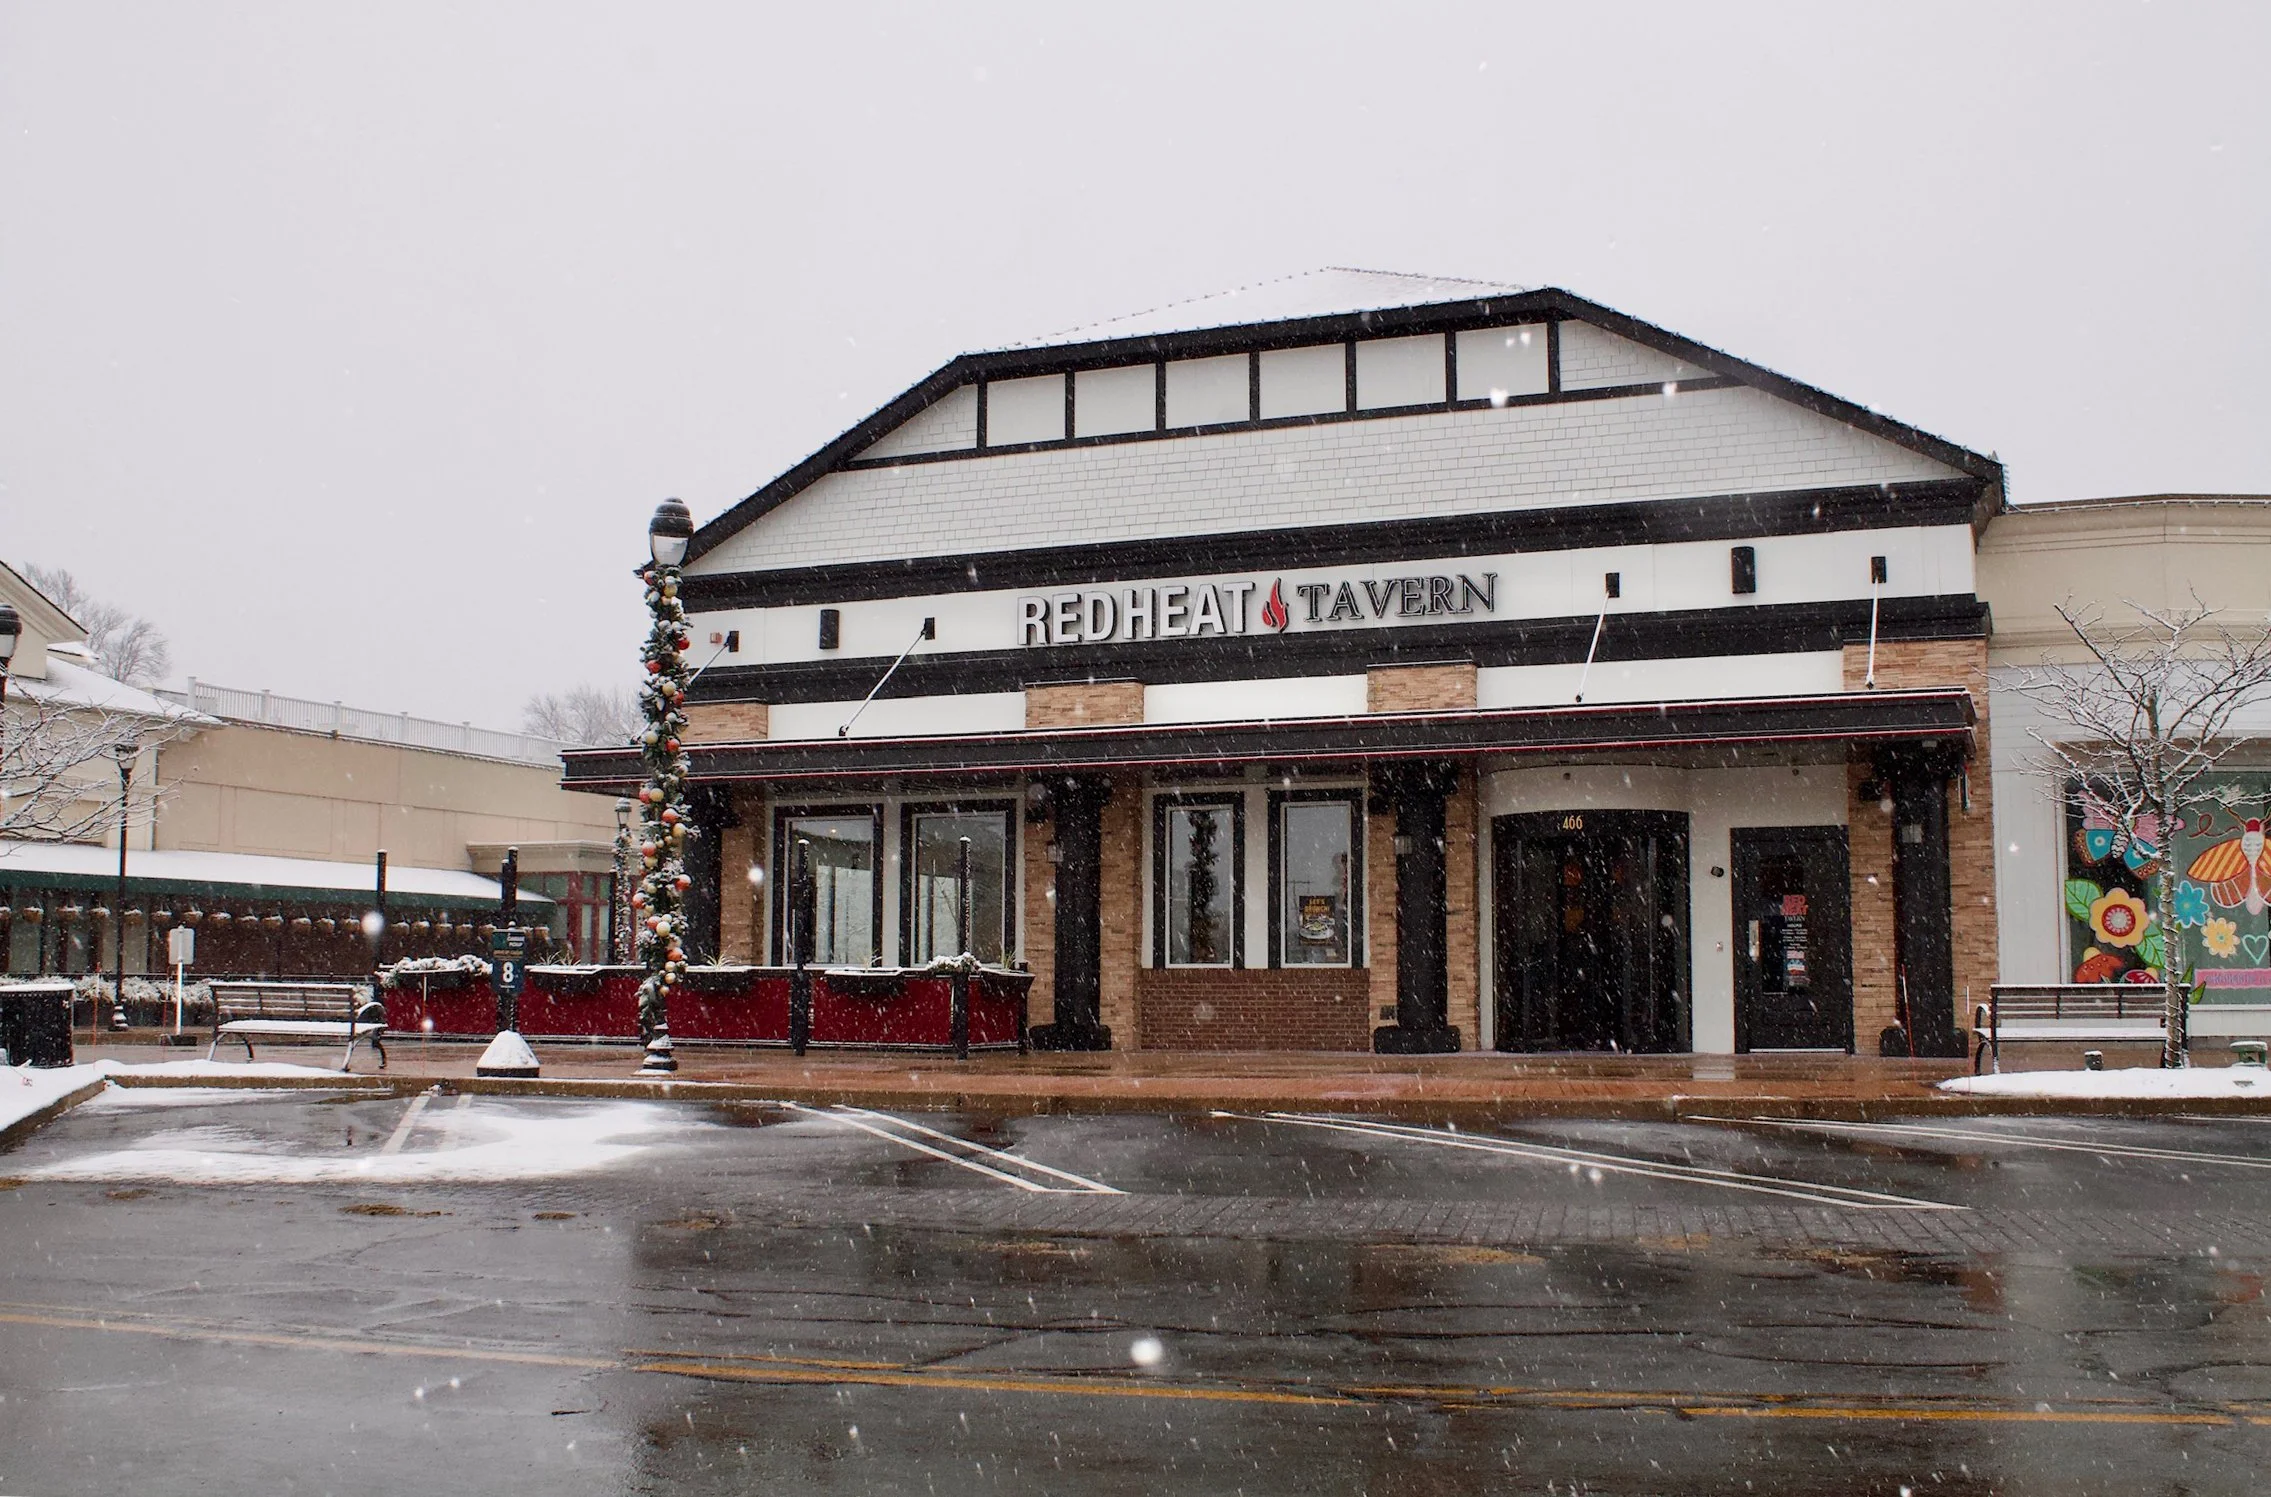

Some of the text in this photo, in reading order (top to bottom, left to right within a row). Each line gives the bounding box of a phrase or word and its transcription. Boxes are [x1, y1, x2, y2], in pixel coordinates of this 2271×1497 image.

[1017, 572, 1498, 646] REDHEAT TAVERN
[1562, 815, 1583, 830] 466
[502, 961, 515, 983] 8
